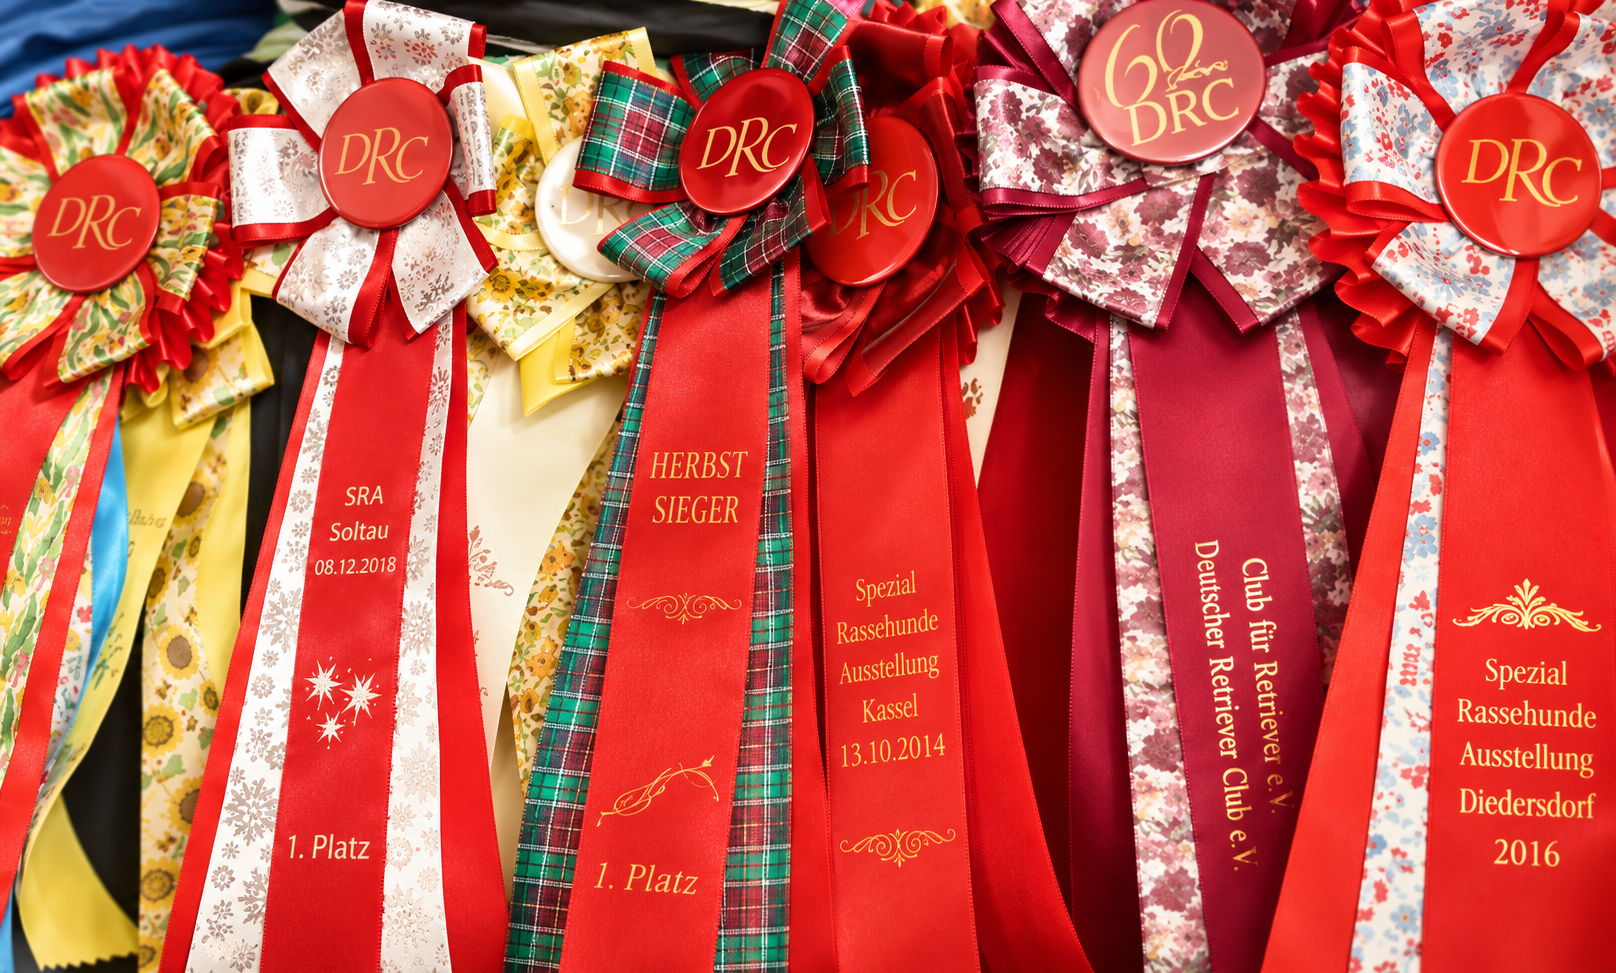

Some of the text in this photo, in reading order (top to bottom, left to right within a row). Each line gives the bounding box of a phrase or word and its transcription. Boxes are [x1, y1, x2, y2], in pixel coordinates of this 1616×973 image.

[1104, 9, 1204, 108] 60
[1123, 77, 1239, 147] DRC
[334, 127, 429, 186] DRC
[697, 116, 799, 178] DRC
[1461, 138, 1584, 208] DRC
[47, 194, 142, 251] DRC
[557, 184, 642, 237] DR
[649, 450, 749, 479] HERBST
[344, 485, 384, 507] SRA
[651, 495, 739, 524] SIEGER
[328, 520, 389, 542] Soltau
[314, 555, 397, 576] 08.12.2018
[855, 570, 917, 608] Spezial
[1242, 558, 1274, 612] Club
[836, 607, 939, 645] Rassehunde
[1249, 619, 1278, 654] für
[838, 651, 940, 685] Ausstellung
[1485, 657, 1568, 691] Spezial
[862, 692, 919, 724] Kassel
[1195, 539, 1259, 872] Deutscher Retriever Club e.V.
[1254, 660, 1284, 766] Retriever
[1456, 697, 1597, 729] Rassehunde
[840, 732, 946, 768] 13.10.2014
[1459, 741, 1595, 779] Ausstellung
[1459, 787, 1597, 819] Diedersdorf
[288, 833, 371, 860] 1. Platz
[1493, 839, 1561, 868] 2016
[593, 862, 699, 895] 1. Platz
